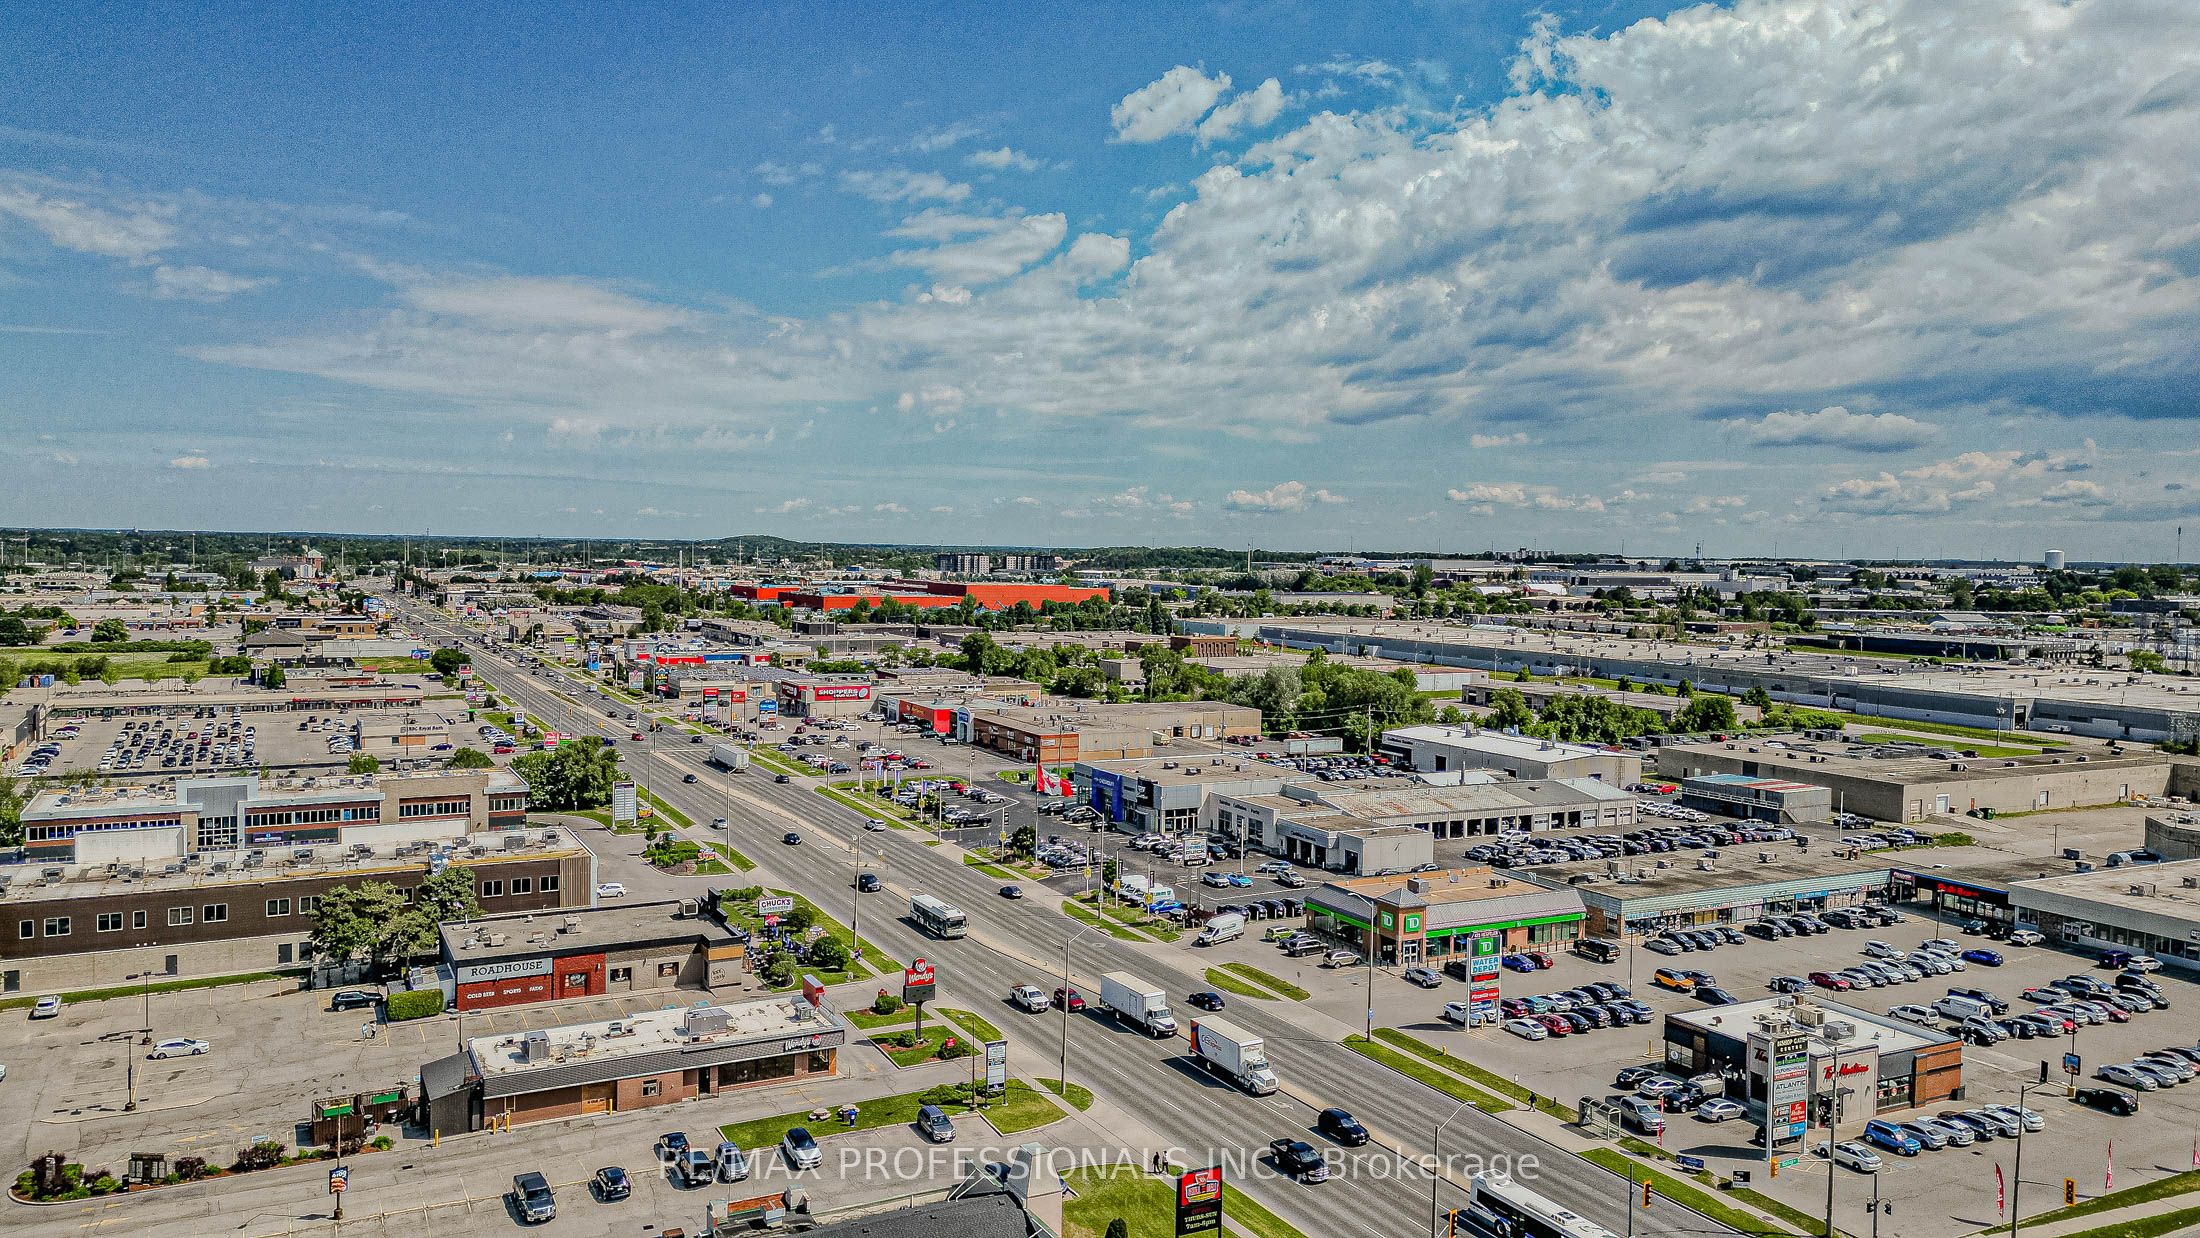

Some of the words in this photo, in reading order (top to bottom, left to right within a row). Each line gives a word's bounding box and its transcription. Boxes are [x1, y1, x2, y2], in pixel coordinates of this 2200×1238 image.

[761, 898, 791, 908] CHUCK'S
[1382, 914, 1392, 927] TD
[1408, 917, 1419, 928] TD
[1480, 941, 1492, 952] TD
[1473, 957, 1499, 966] WATER
[471, 961, 543, 977] ROADHOUSE
[1473, 964, 1499, 973] DEPOT
[1776, 1080, 1806, 1090] ATLANTIC
